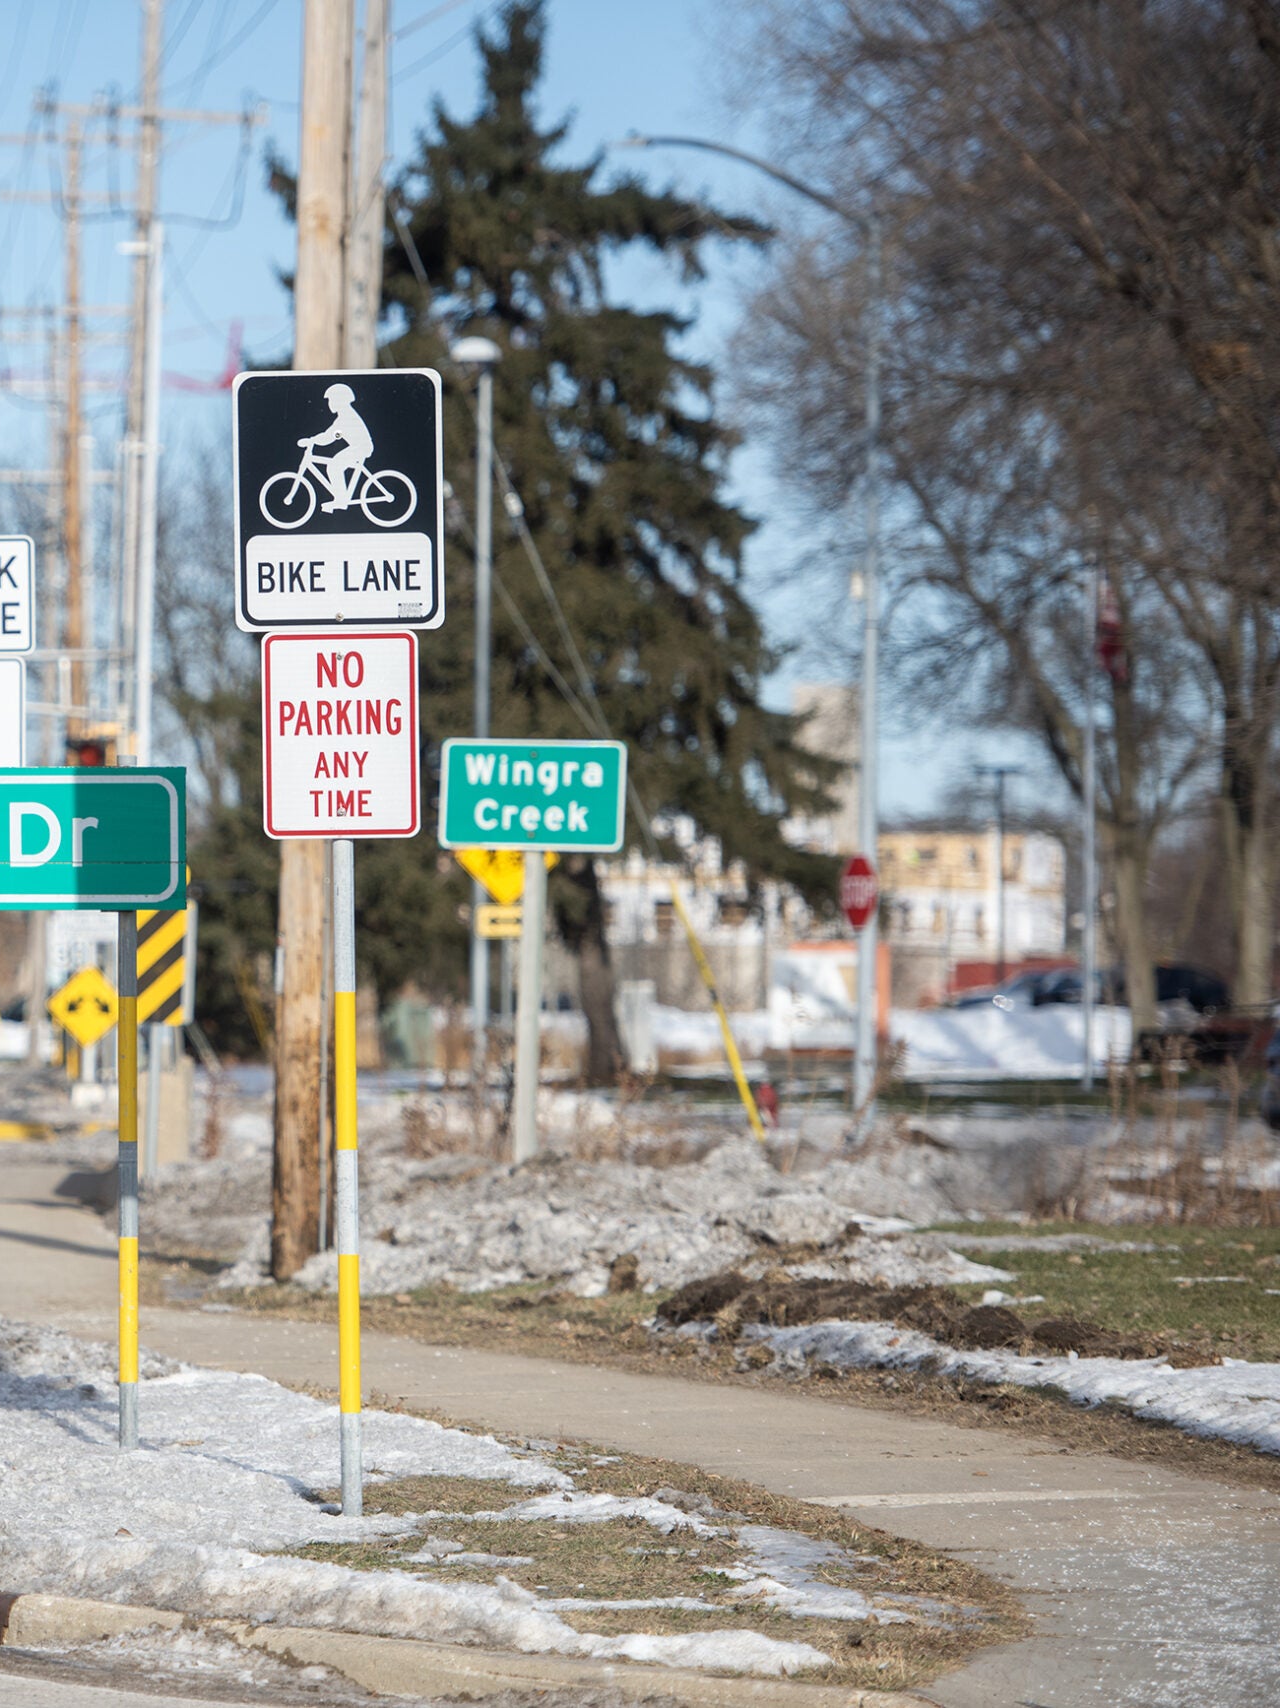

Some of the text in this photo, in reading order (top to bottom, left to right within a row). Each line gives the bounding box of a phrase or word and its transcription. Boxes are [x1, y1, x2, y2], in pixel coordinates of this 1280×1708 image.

[257, 559, 422, 594] BIKE LANE
[316, 651, 365, 689] NO
[279, 698, 402, 737] PARKING
[314, 751, 370, 779] ANY
[465, 753, 605, 796] Wingra
[309, 789, 373, 818] TIME
[473, 799, 589, 833] Creek
[8, 801, 99, 869] Dr
